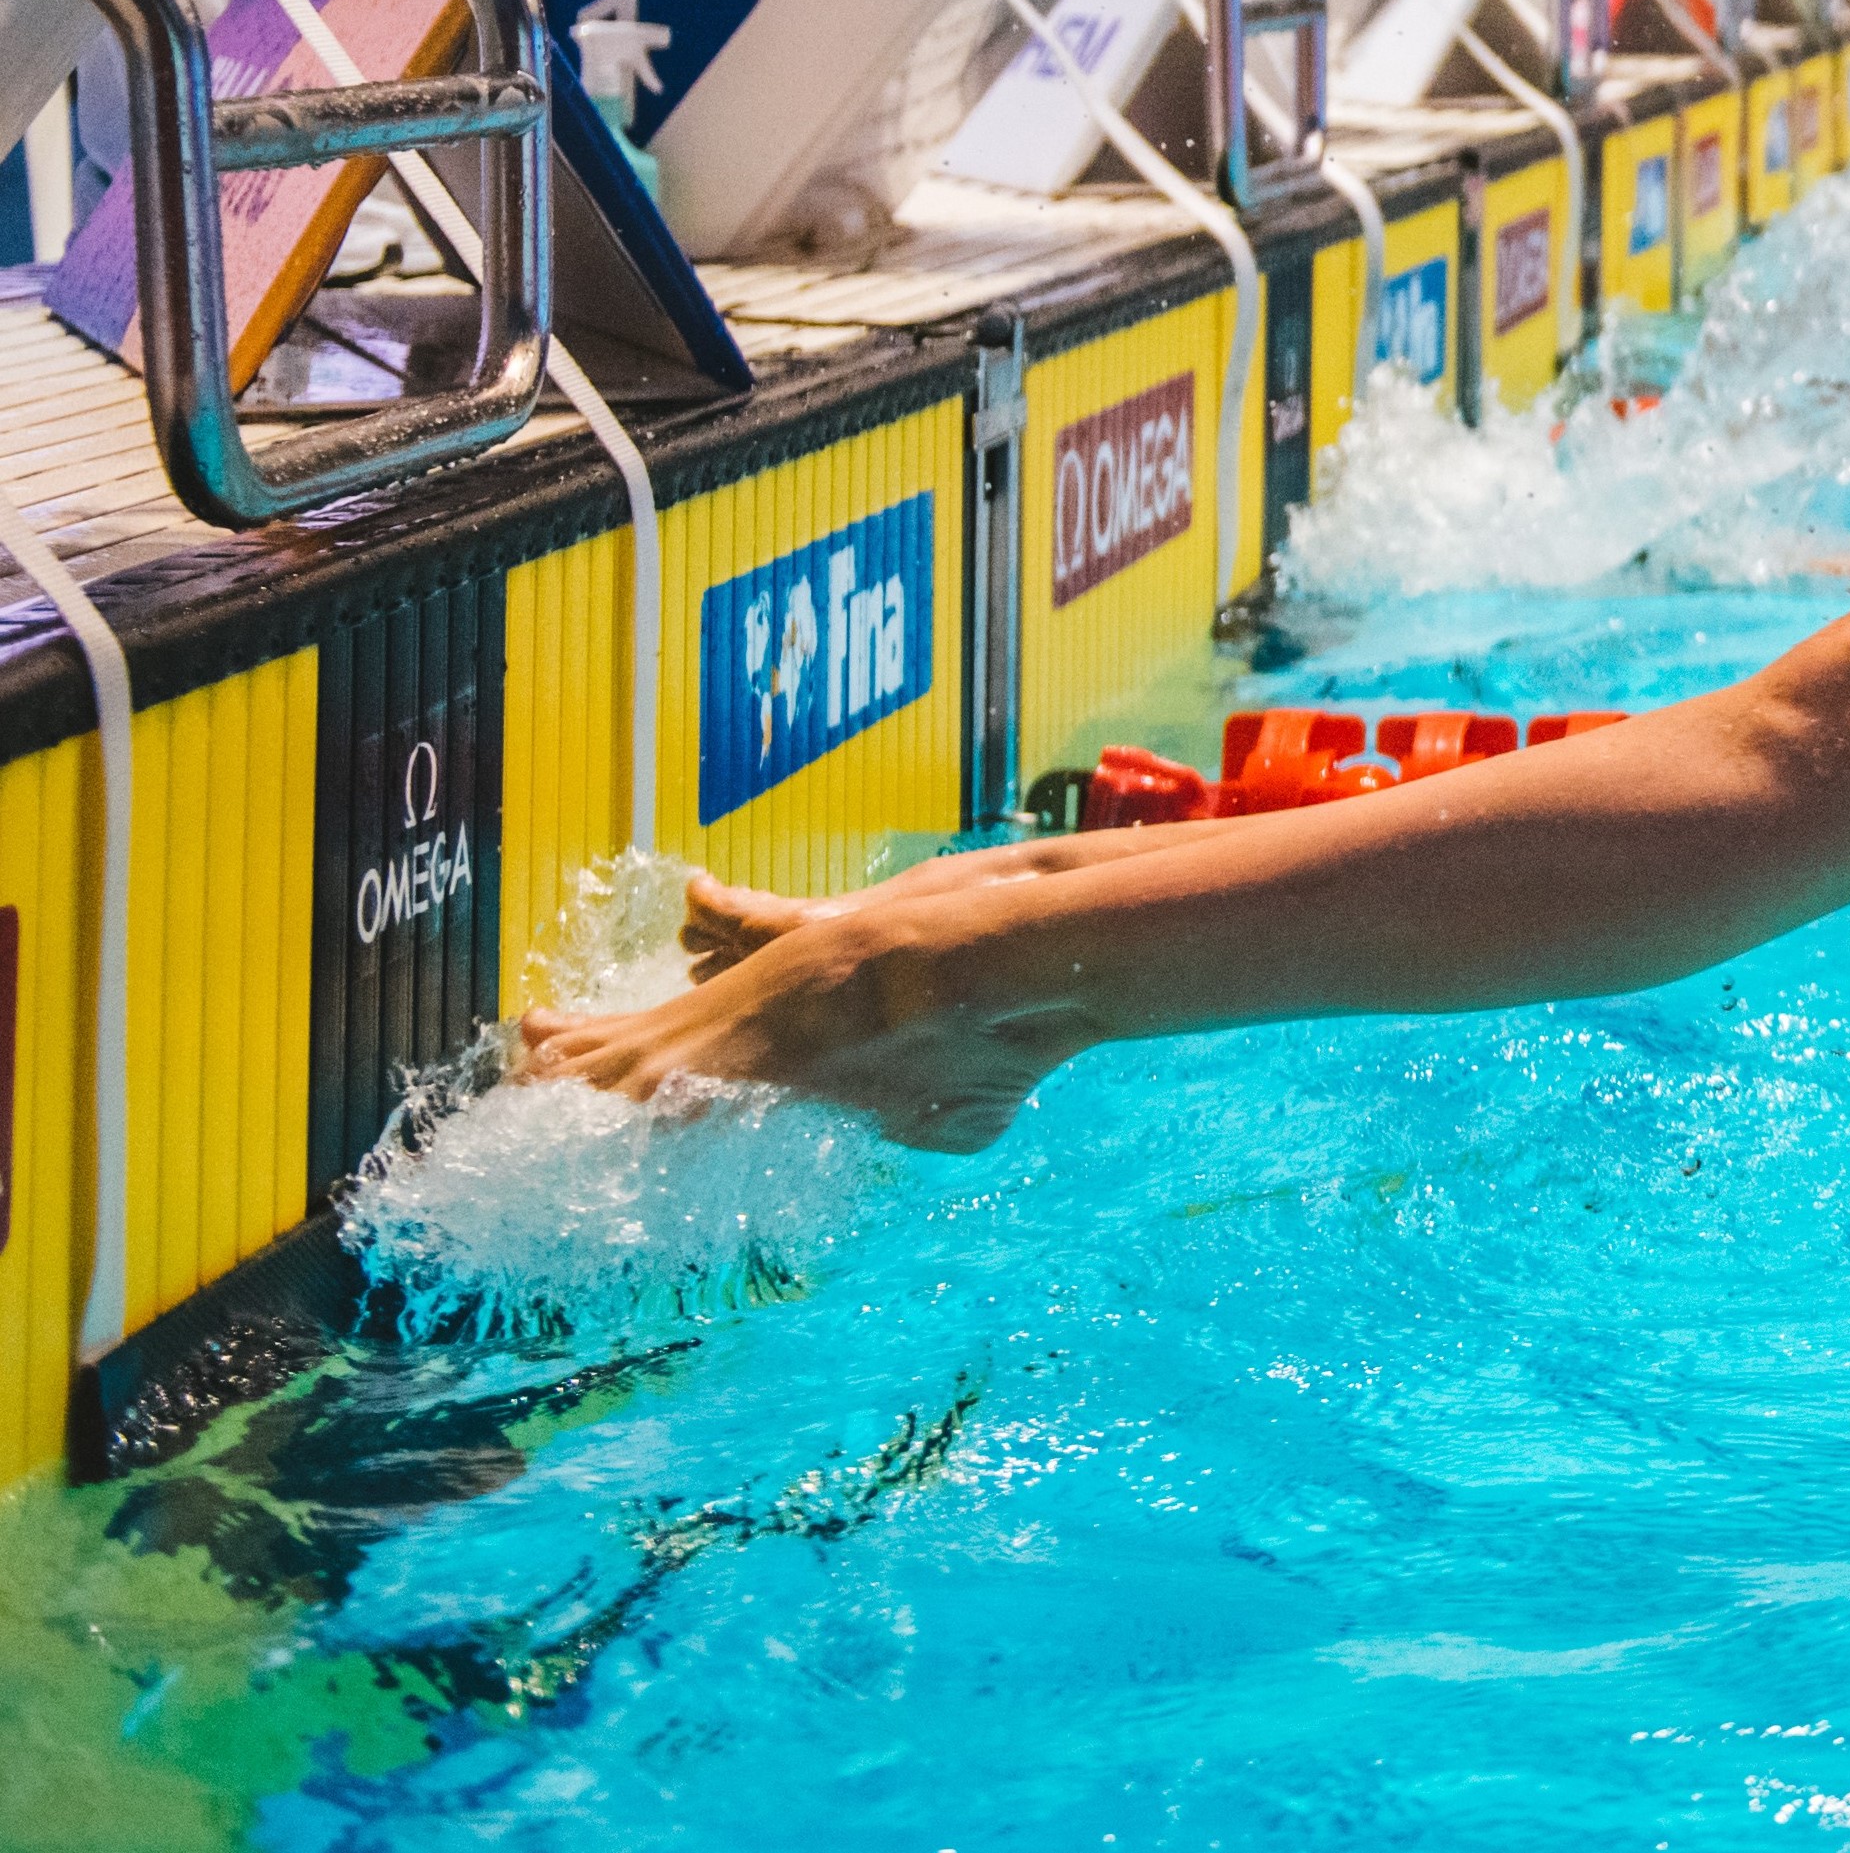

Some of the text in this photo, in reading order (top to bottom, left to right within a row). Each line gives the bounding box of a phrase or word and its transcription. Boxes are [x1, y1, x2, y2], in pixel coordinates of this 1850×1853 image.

[1091, 405, 1192, 555] OMEGA
[827, 544, 904, 729] fina
[357, 819, 472, 943] OMEGA
